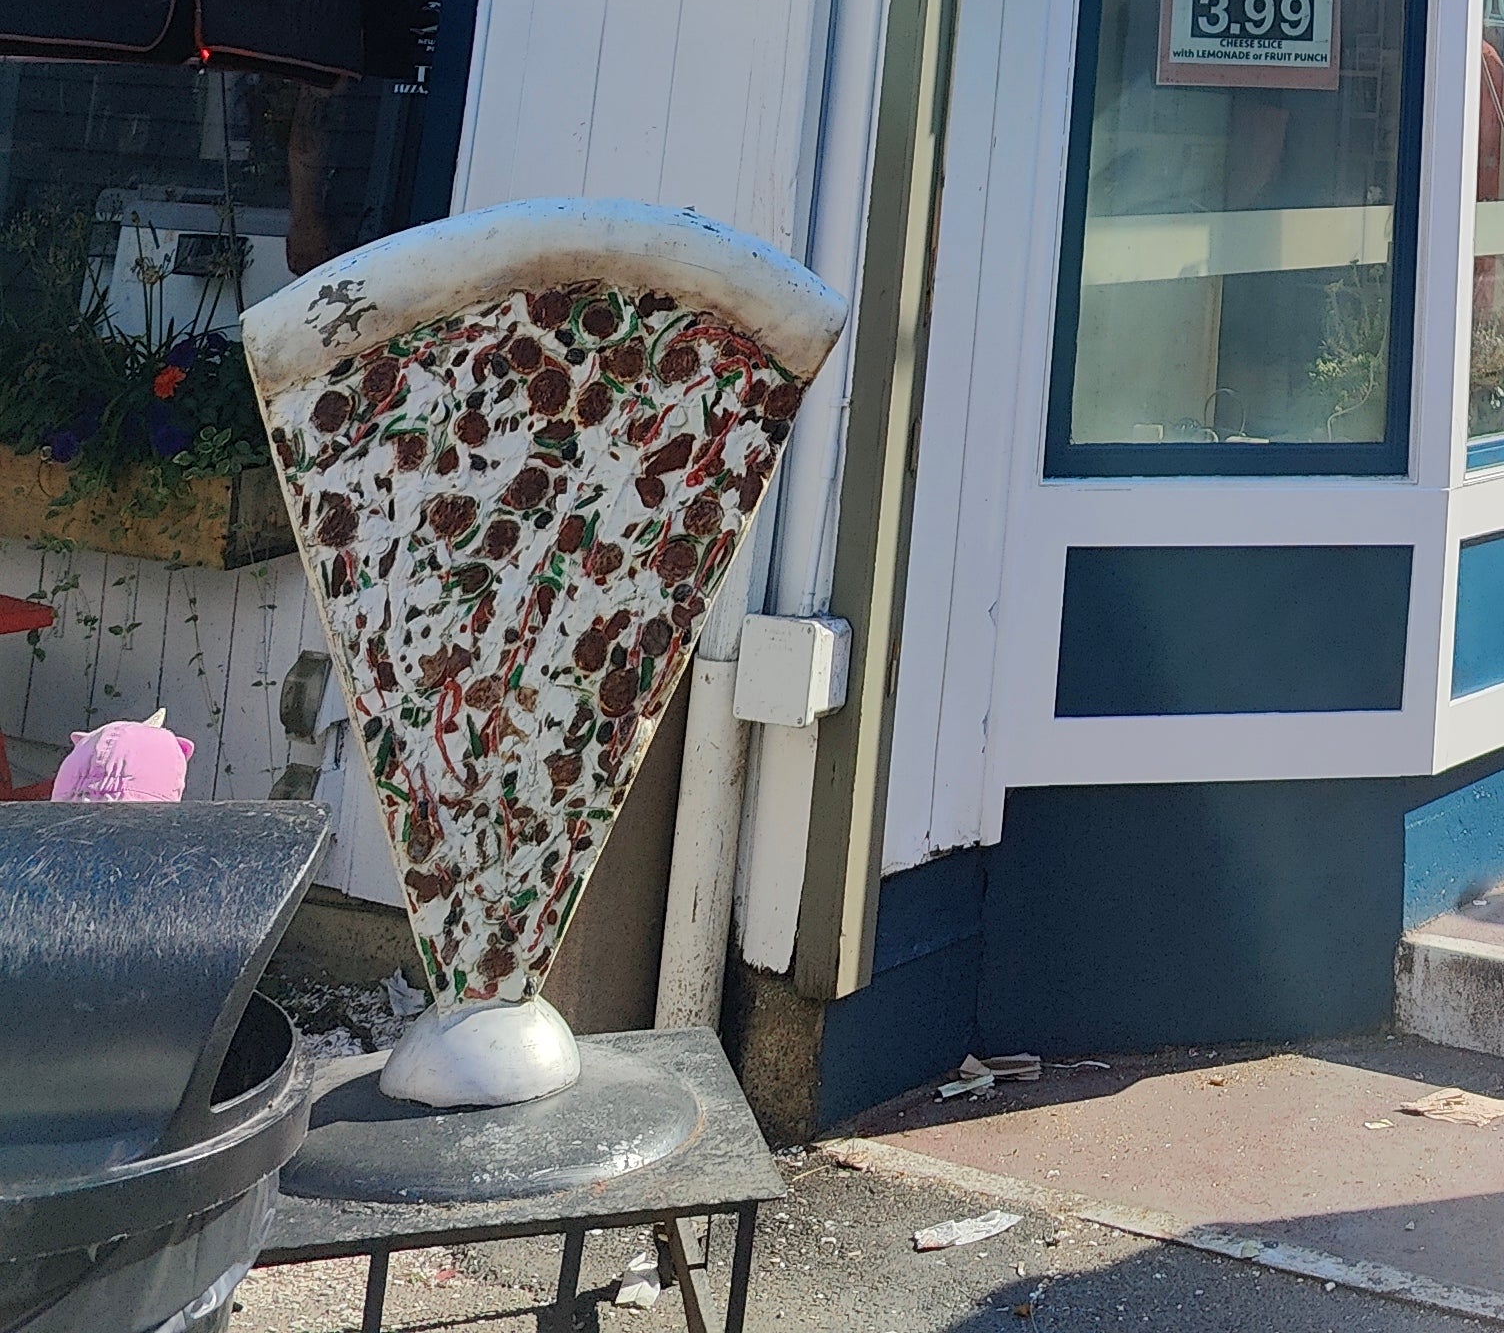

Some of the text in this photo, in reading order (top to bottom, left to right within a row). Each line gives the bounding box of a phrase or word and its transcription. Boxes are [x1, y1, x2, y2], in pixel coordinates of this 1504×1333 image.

[1219, 38, 1283, 50] CHEESE SLICE
[1172, 47, 1328, 63] with LEMONADE or FRUIT PUNCH
